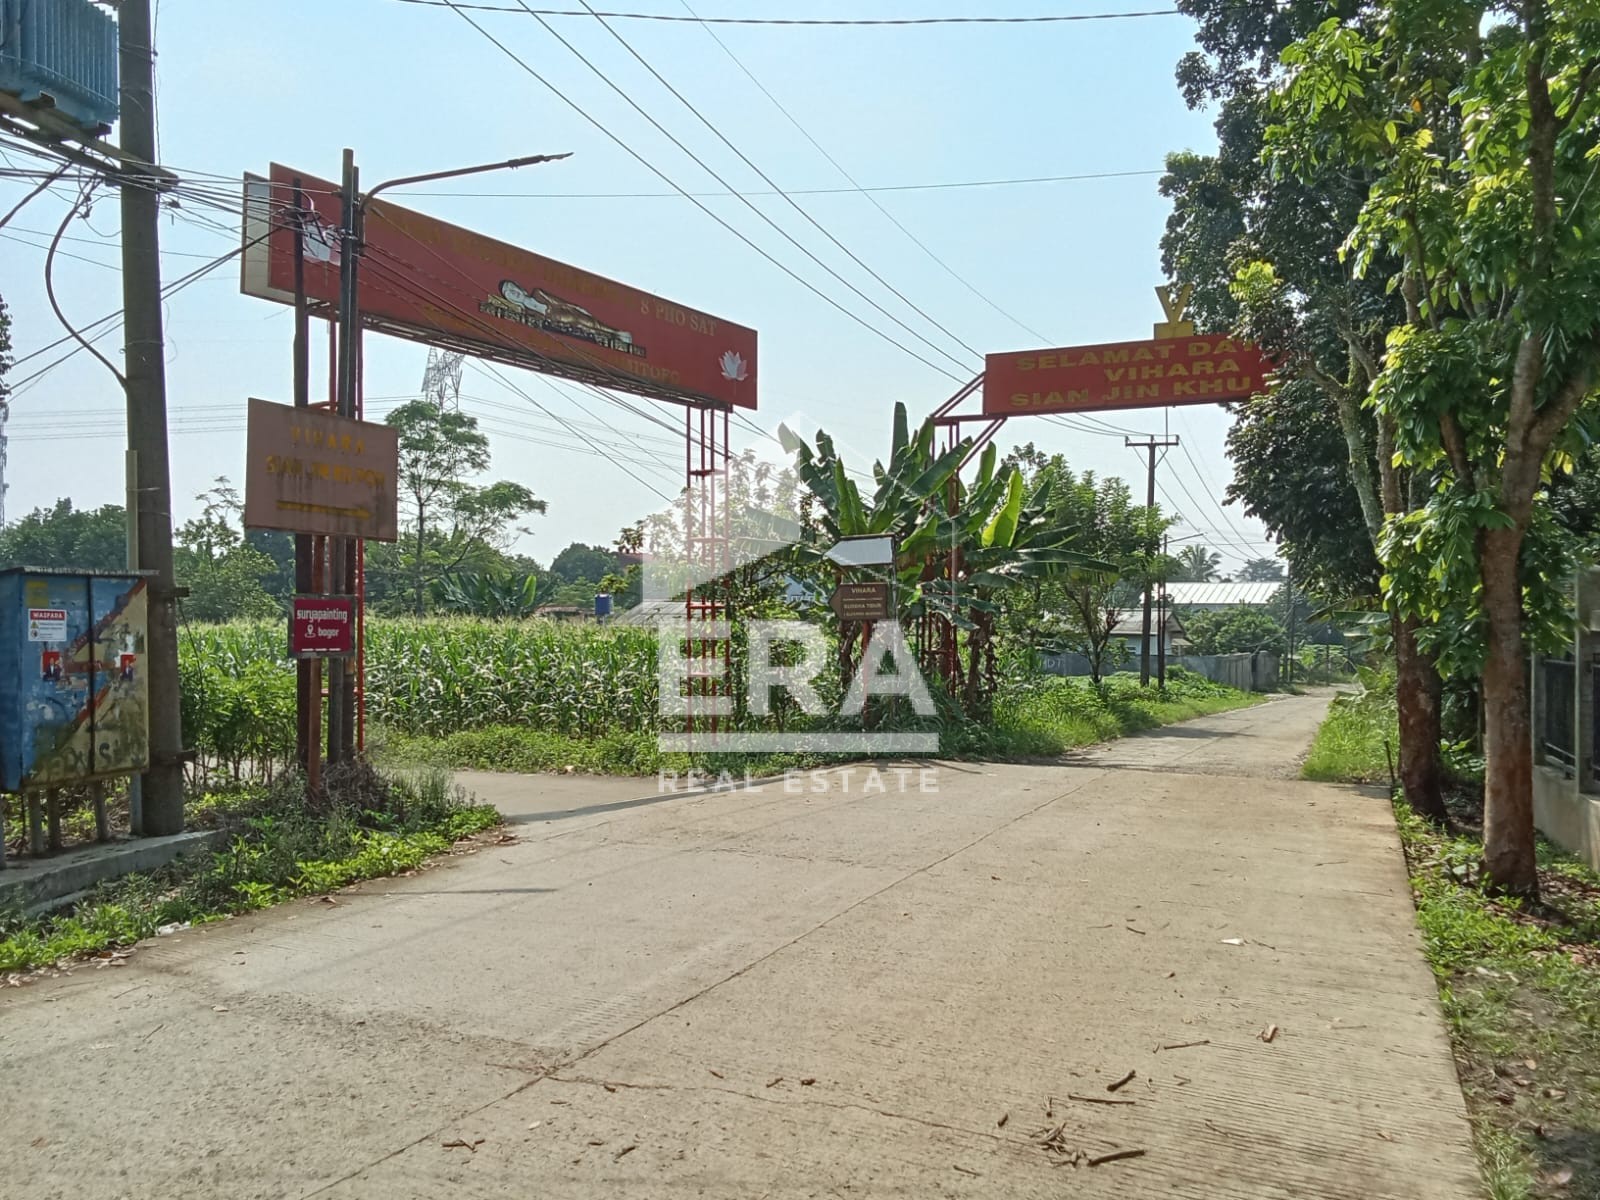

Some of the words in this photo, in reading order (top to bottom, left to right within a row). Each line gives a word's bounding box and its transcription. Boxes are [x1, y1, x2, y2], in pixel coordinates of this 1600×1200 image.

[640, 298, 650, 315] 8
[690, 313, 718, 337] SAT
[1016, 344, 1175, 371] SELAMAT
[1104, 358, 1241, 381] VIHARA
[1009, 389, 1089, 407] SIAN
[1102, 382, 1160, 401] JIN
[1173, 376, 1251, 396] KHU
[290, 425, 366, 455] VIHARA
[318, 627, 339, 639] bogor
